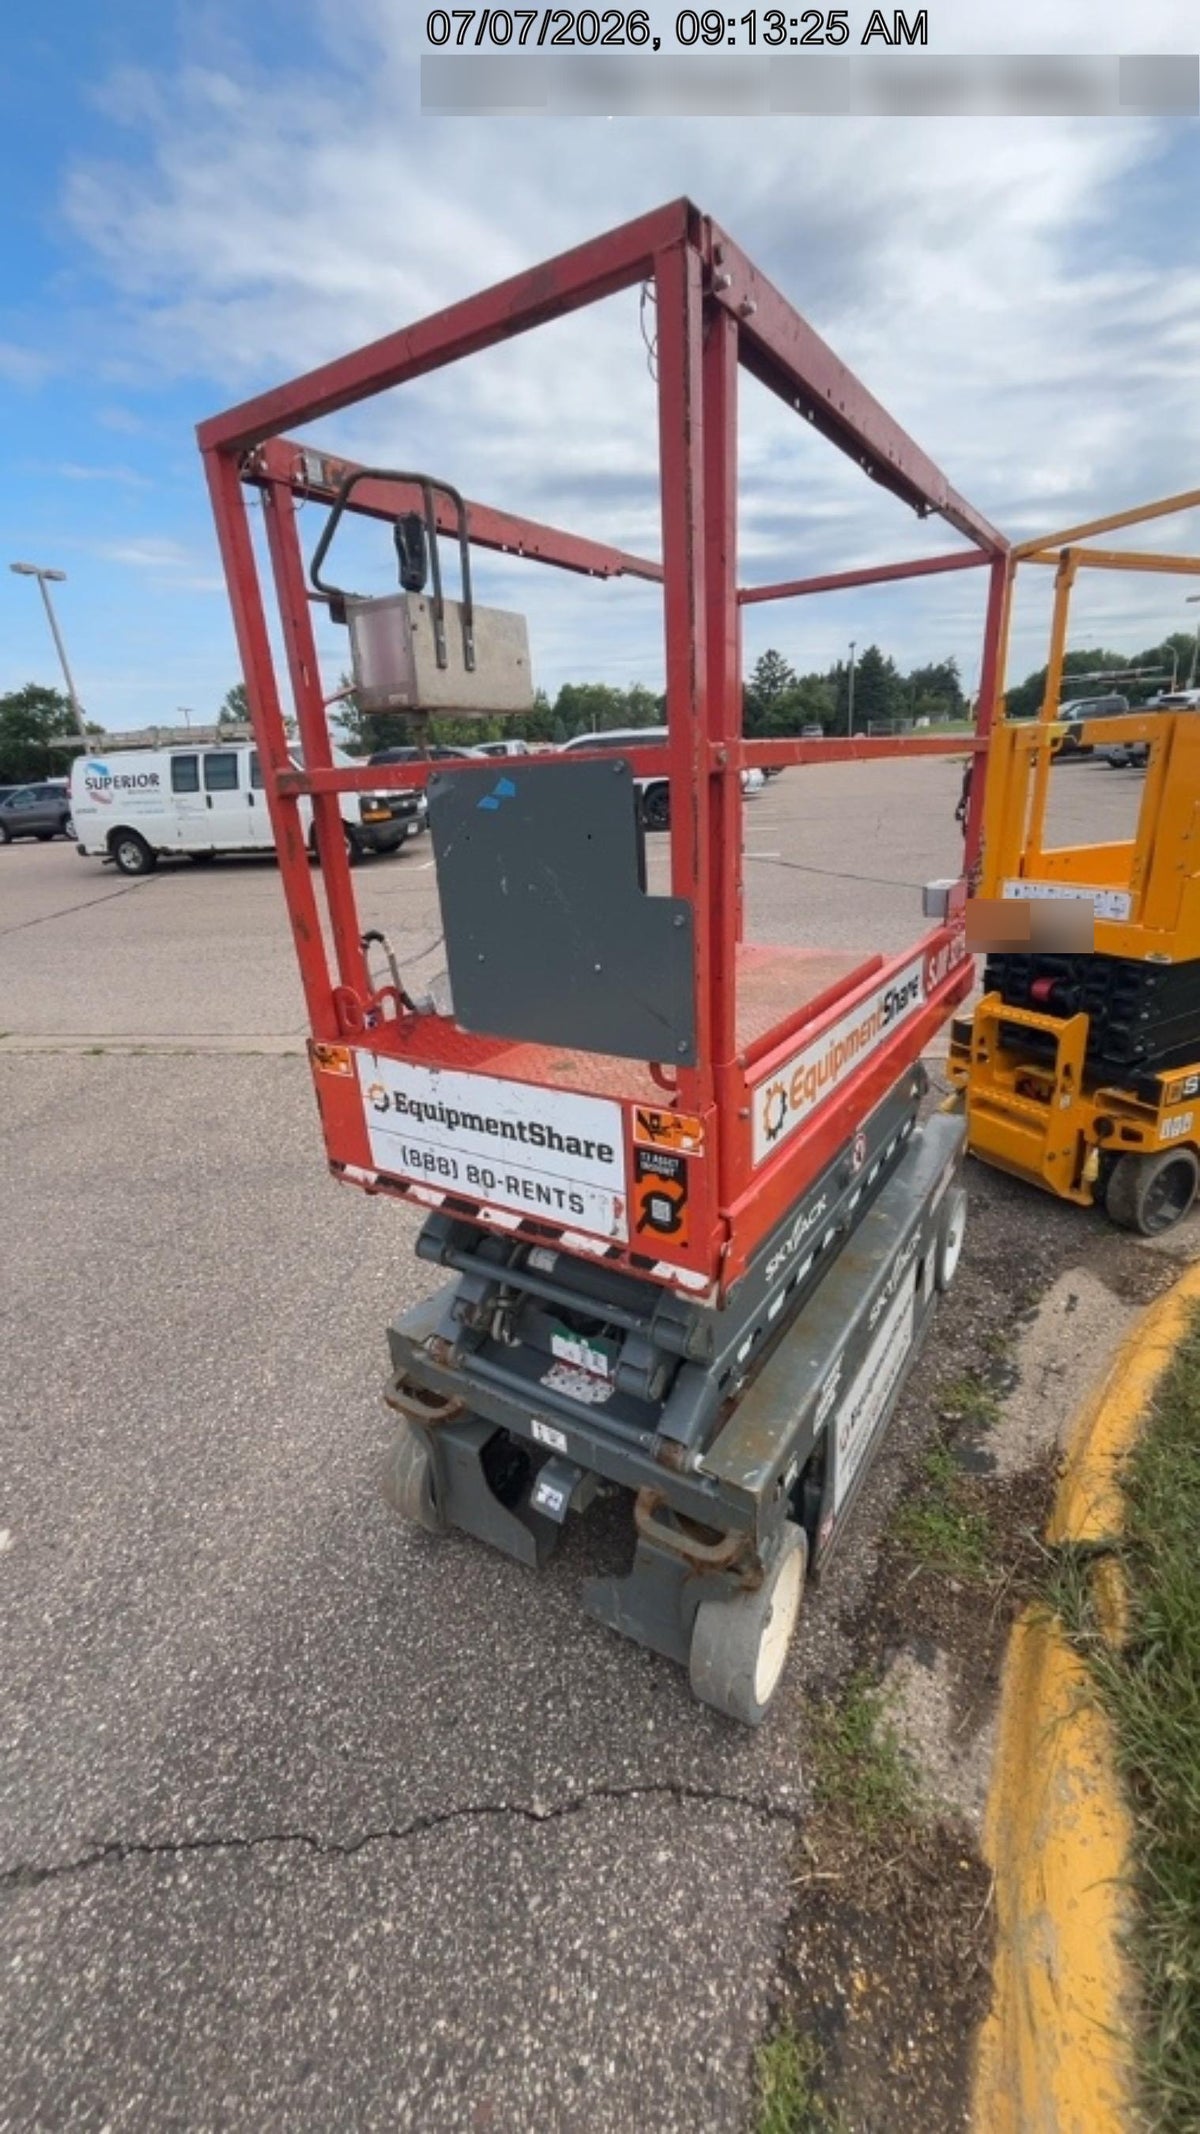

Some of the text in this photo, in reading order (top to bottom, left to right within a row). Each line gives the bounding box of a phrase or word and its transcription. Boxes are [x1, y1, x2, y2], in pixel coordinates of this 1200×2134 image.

[85, 772, 160, 791] SUPERIOR
[789, 974, 921, 1112] EquipmentShare
[393, 1090, 615, 1164] EquipmentShare
[401, 1144, 585, 1215] (888) 80-RENTS
